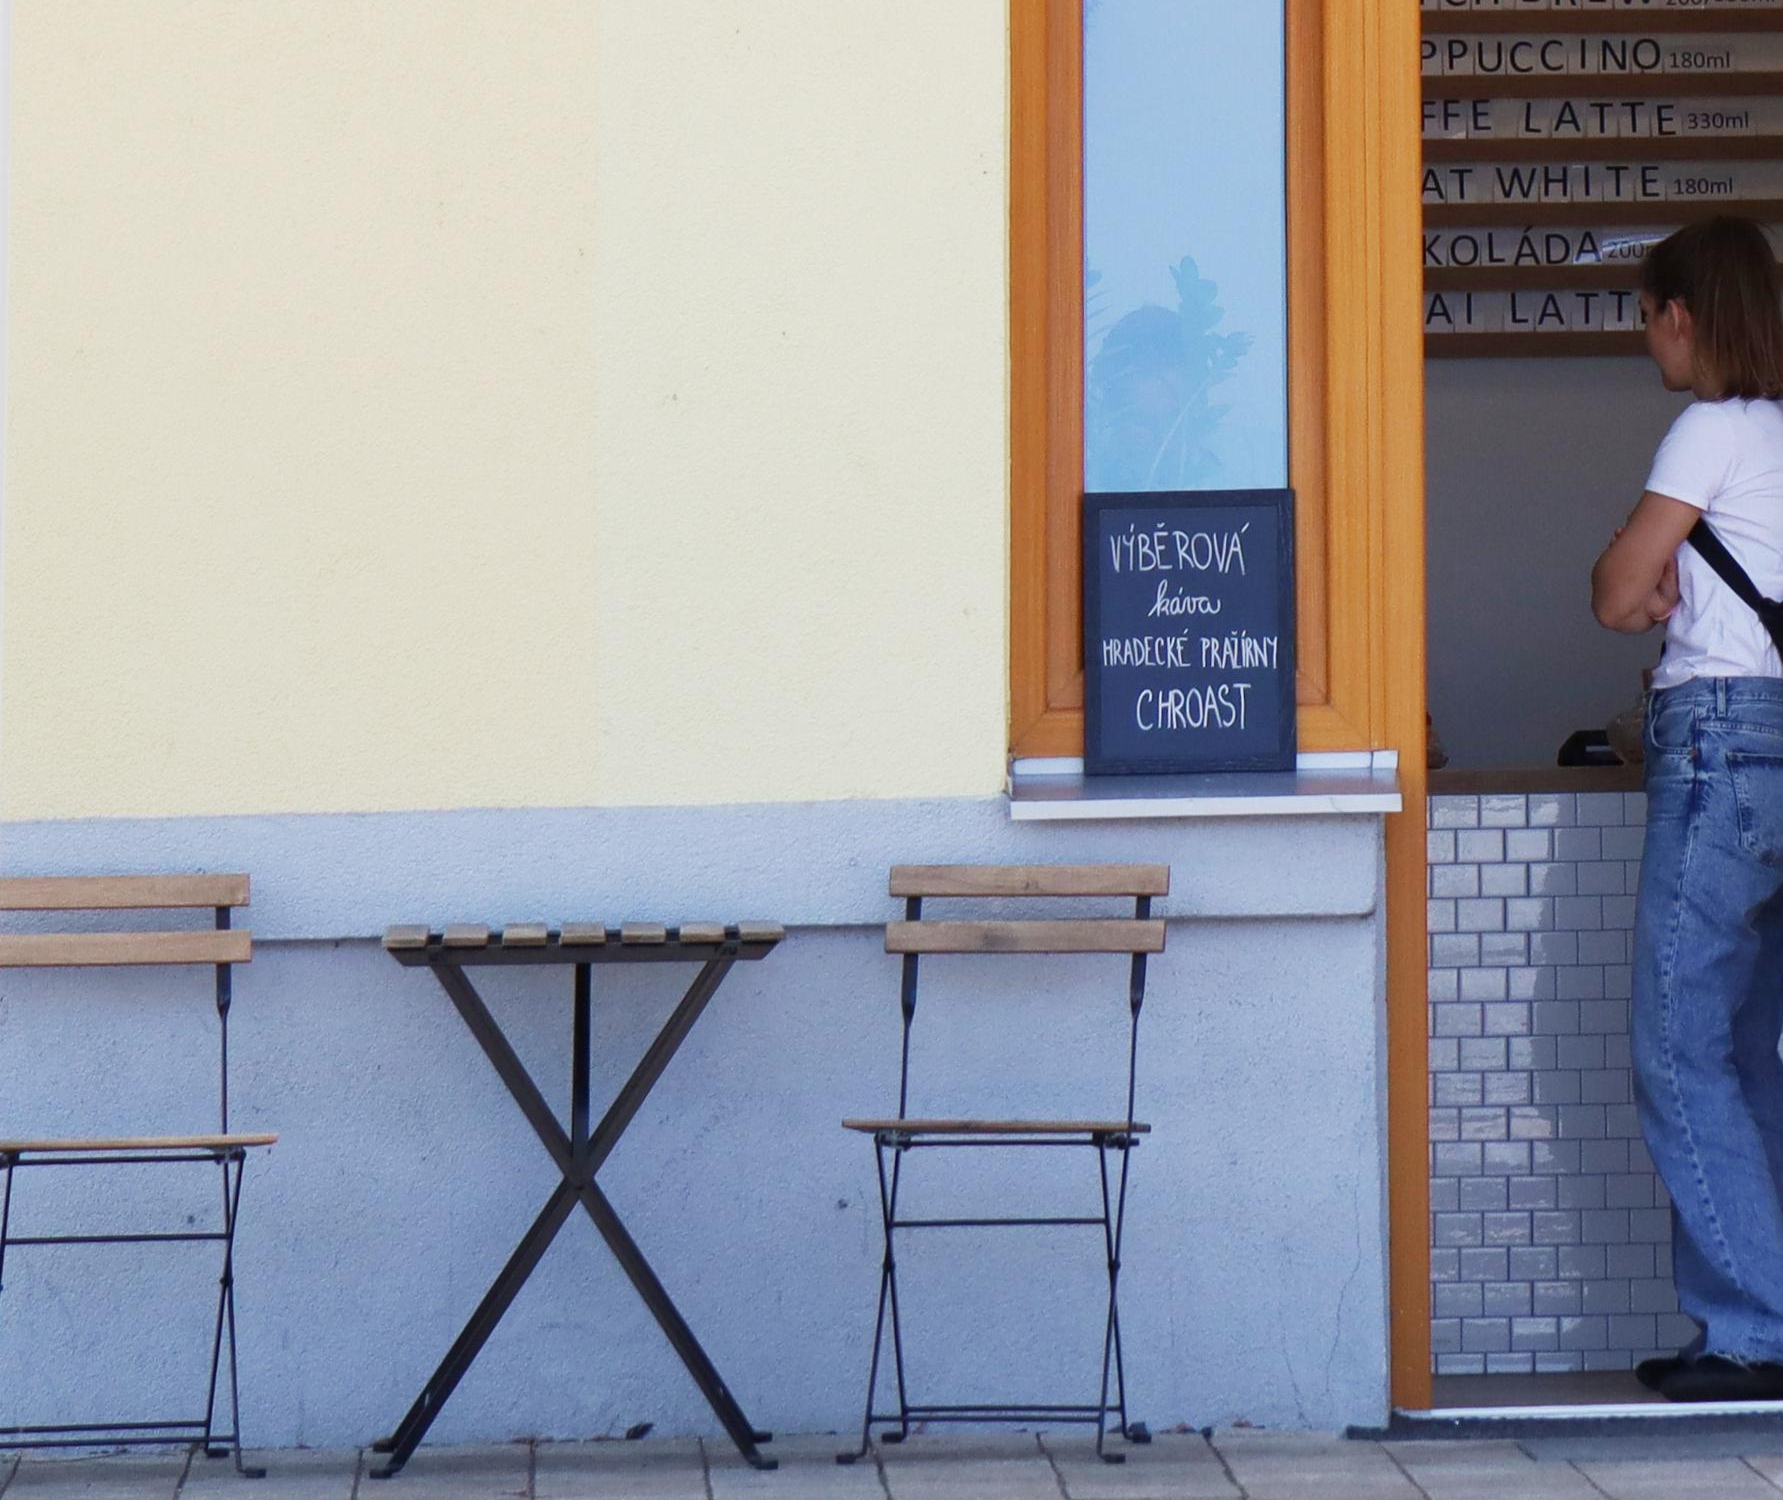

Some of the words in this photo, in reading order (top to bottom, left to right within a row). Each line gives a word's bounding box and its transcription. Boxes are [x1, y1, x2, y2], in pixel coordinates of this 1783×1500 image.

[1669, 51, 1731, 70] 180ml
[1524, 100, 1677, 136] LATTE
[1687, 112, 1749, 130] 330ml
[1495, 165, 1661, 199] WHITE
[1673, 176, 1734, 197] 180ml
[1510, 291, 1647, 325] LATT
[1110, 521, 1250, 576] VÝBĚROVÁ
[1147, 578, 1222, 617] káva
[1102, 628, 1191, 669] HRADECKÉ
[1200, 630, 1278, 669] PRAŽÍRNY
[1136, 683, 1252, 730] CHROAST
